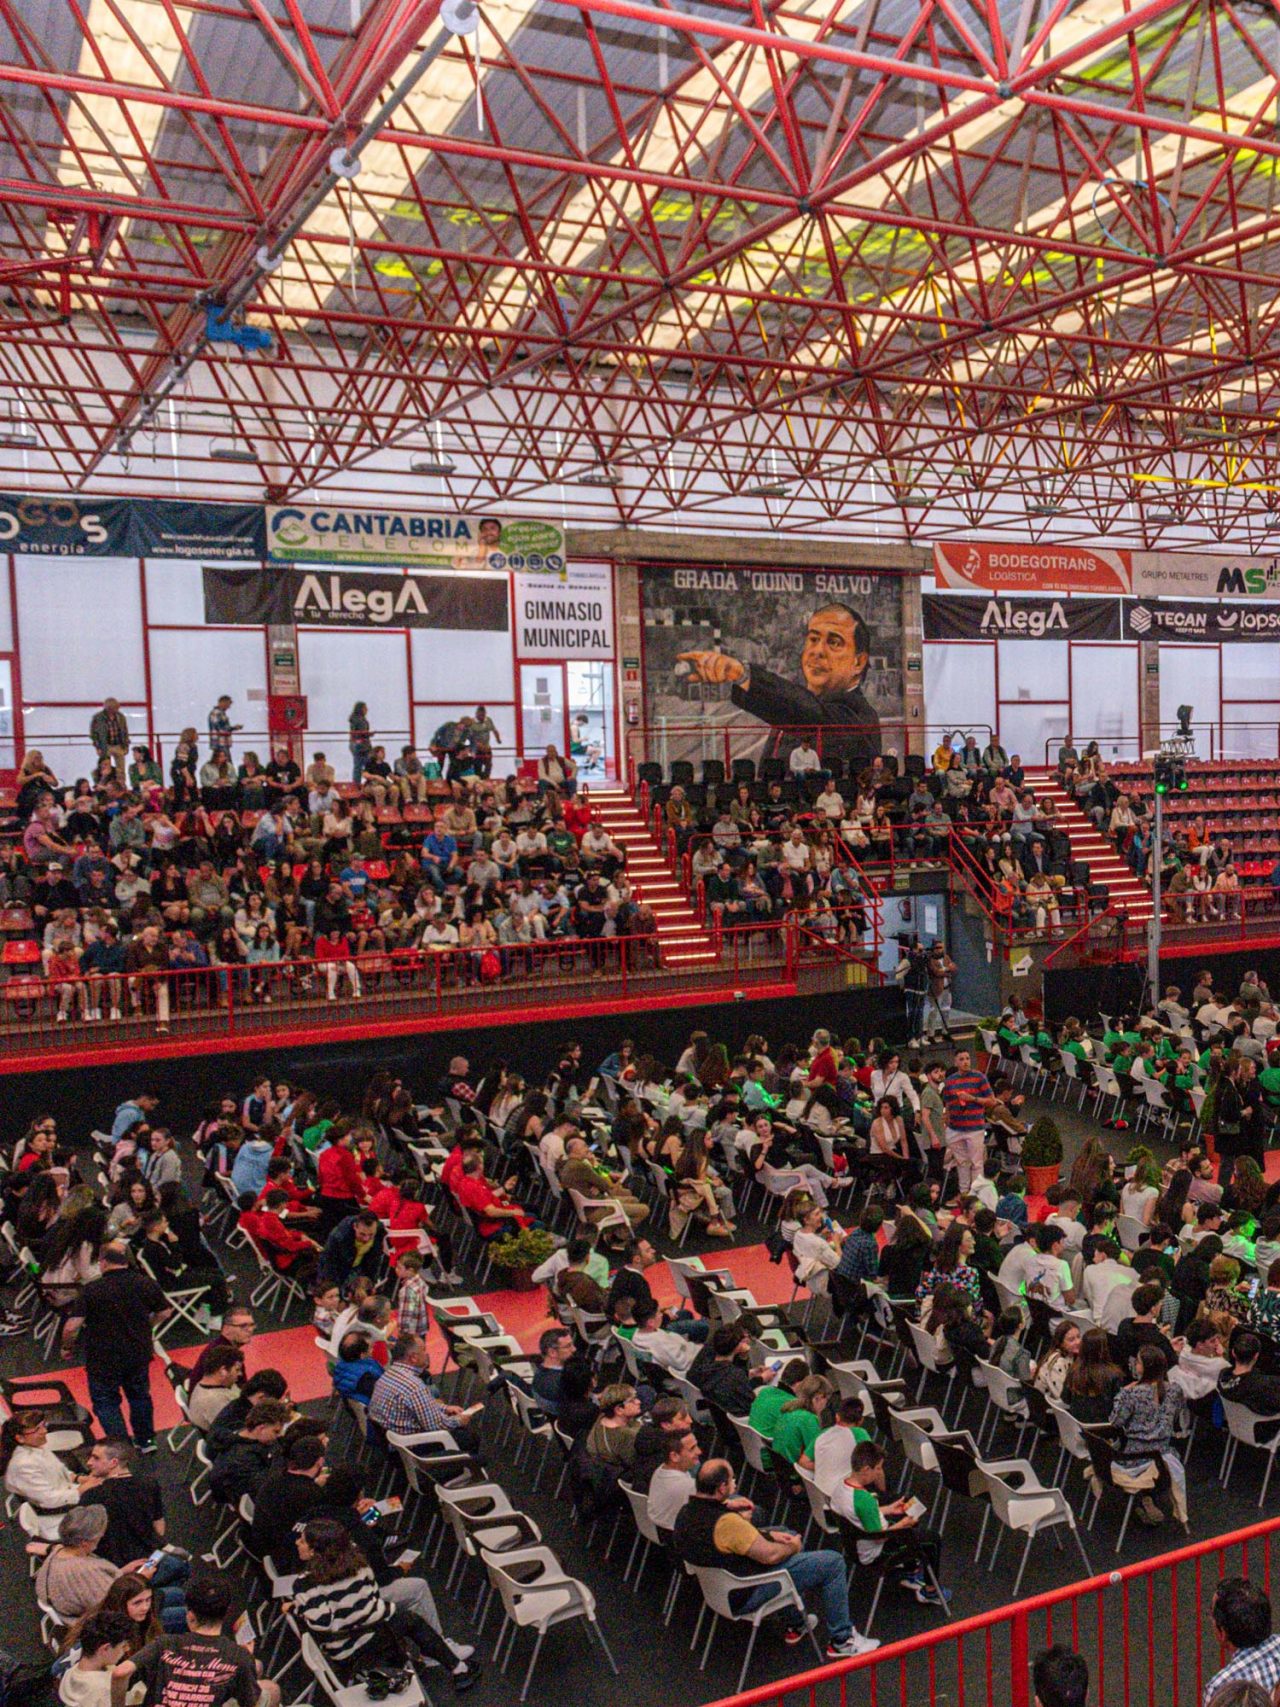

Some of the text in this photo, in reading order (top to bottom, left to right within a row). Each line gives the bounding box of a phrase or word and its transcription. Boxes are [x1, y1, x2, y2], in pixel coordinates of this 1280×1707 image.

[310, 512, 472, 540] CANTABRIA
[316, 534, 470, 552] TELECOM
[989, 553, 1097, 572] BODEGOTRANS
[674, 570, 738, 591] GRADA
[815, 574, 879, 595] SALVO"
[989, 571, 1037, 582] LOGÍSTICA
[1142, 570, 1209, 581] GRUPO METALTRES
[1216, 566, 1268, 594] MS
[293, 575, 430, 623] AlegA
[525, 600, 602, 621] GIMNASIO
[980, 600, 1069, 637] AlegA
[1154, 610, 1208, 627] TECAN
[523, 628, 611, 649] MUNICIPAL
